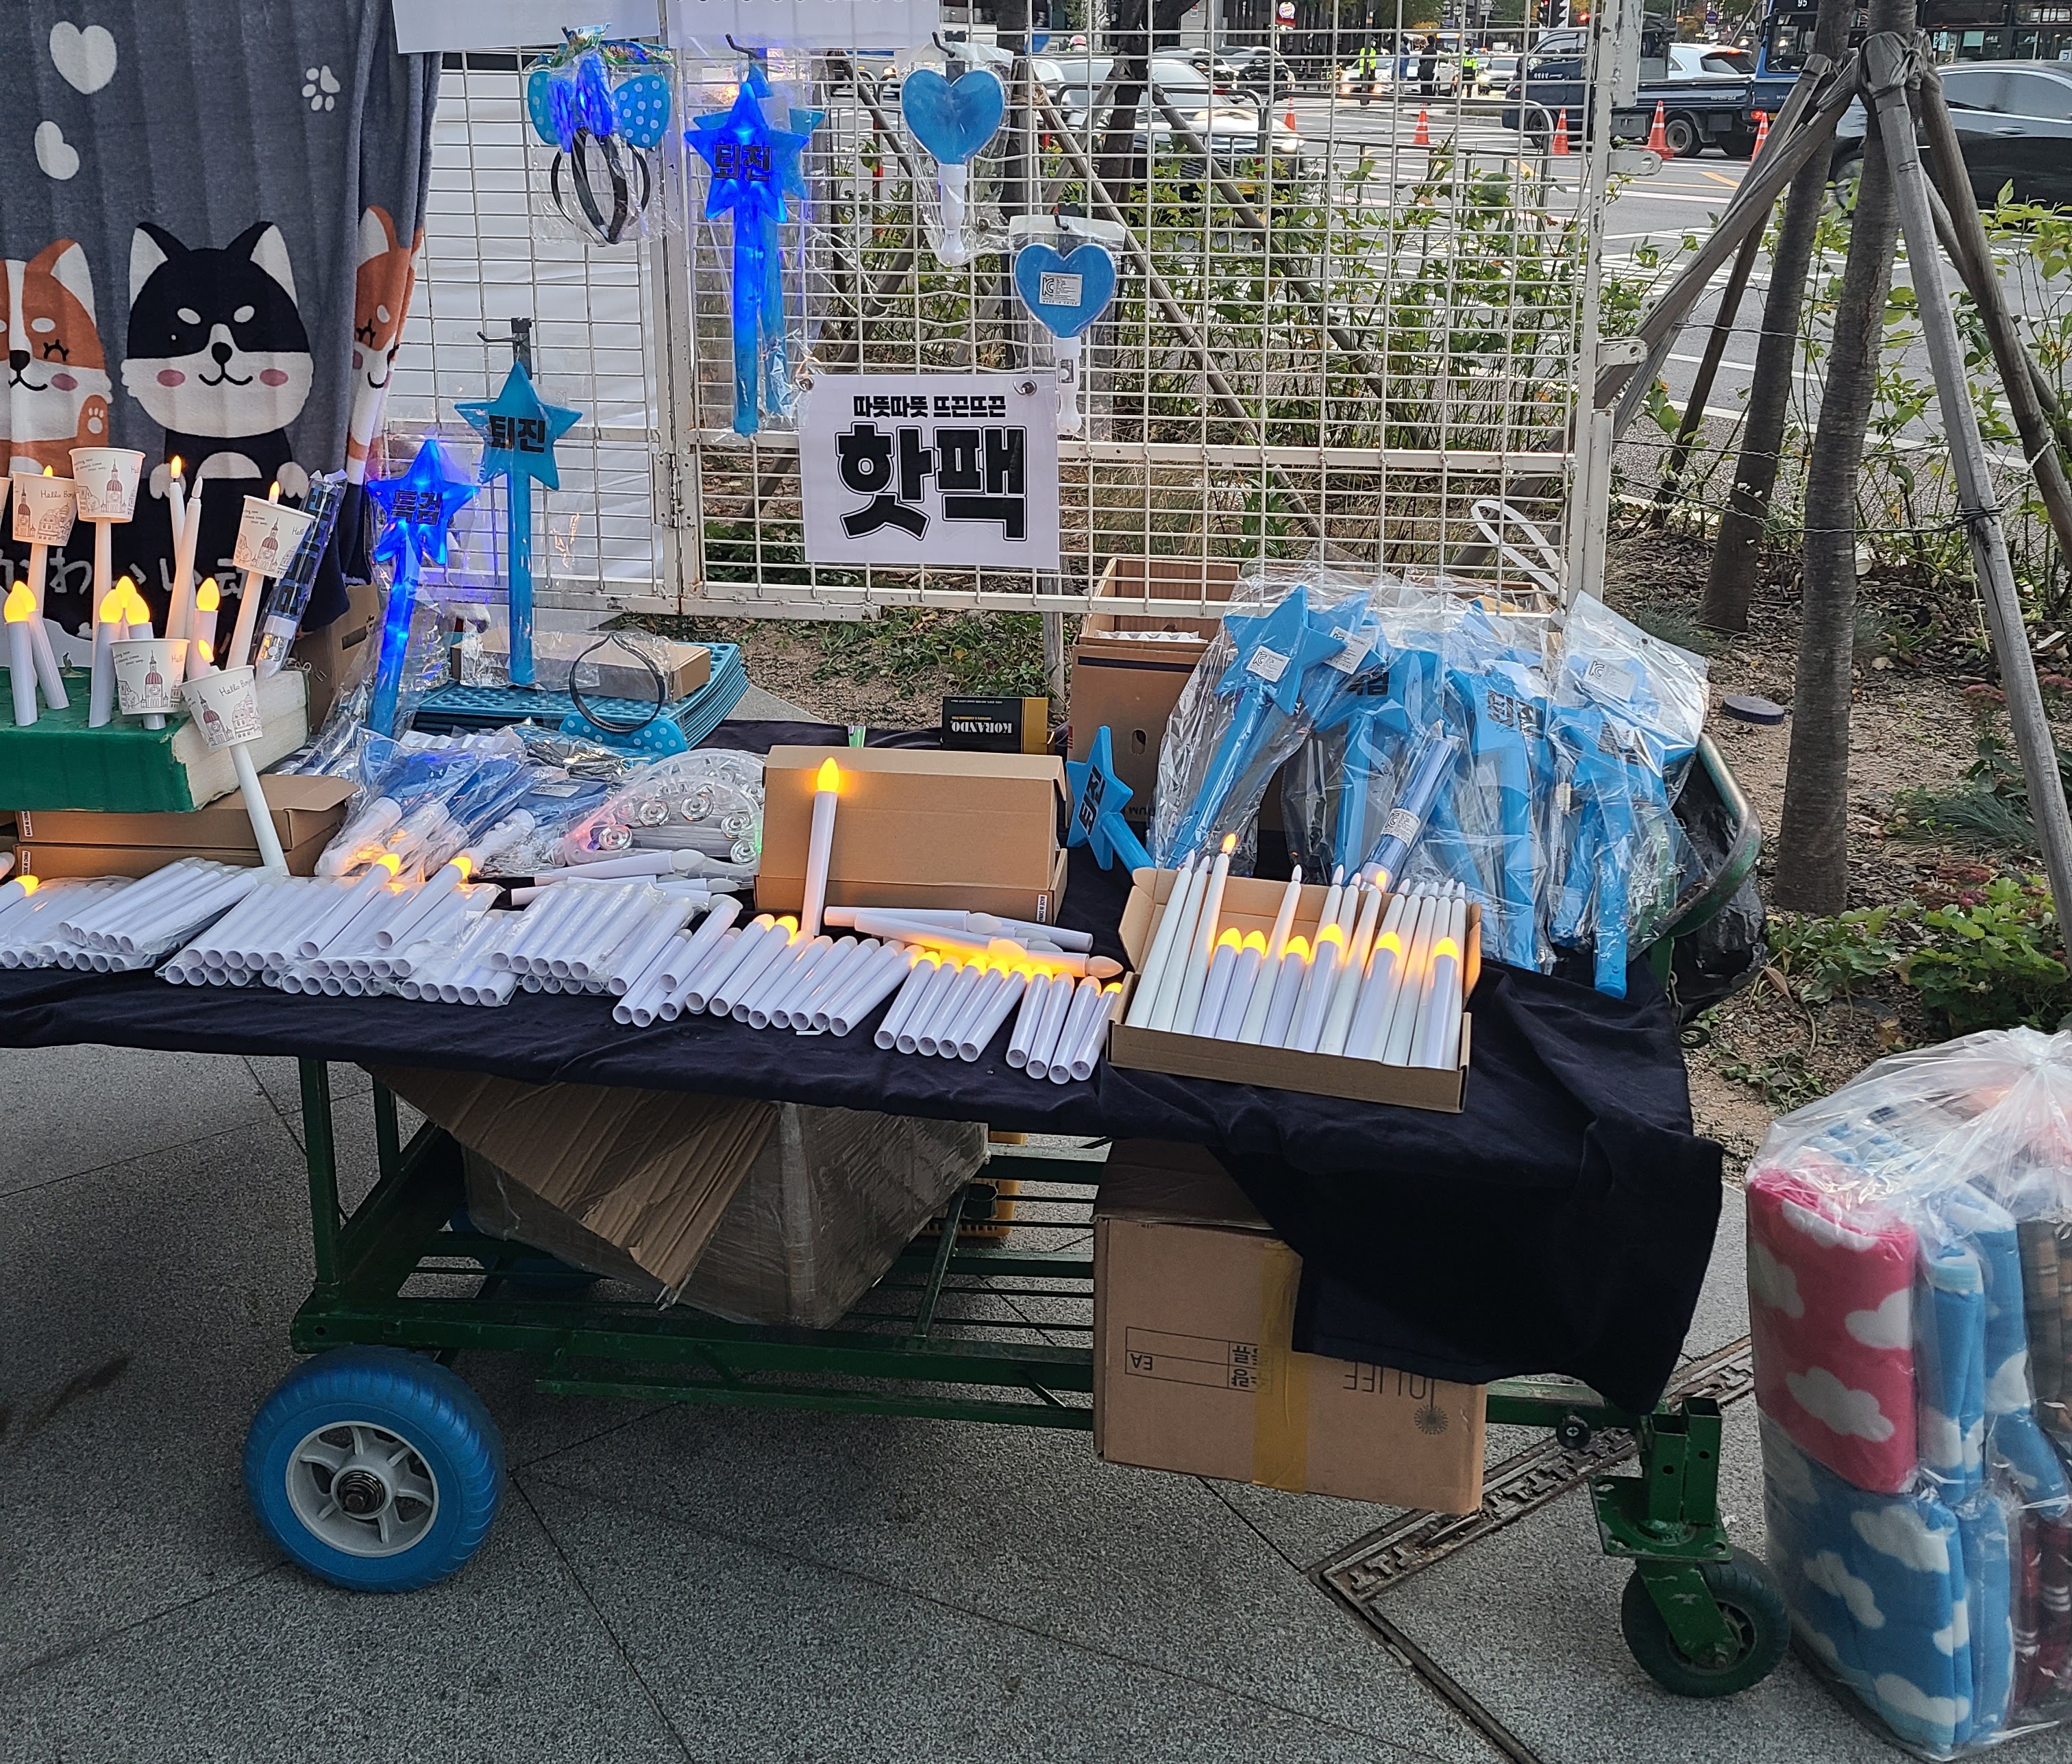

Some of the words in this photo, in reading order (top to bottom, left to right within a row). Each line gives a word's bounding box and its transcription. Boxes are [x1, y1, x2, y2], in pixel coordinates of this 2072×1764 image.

[714, 144, 772, 182] 퇴진
[853, 395, 929, 418] 따뜻따뜻
[933, 395, 1006, 418] 뜨끈뜨끈
[489, 414, 547, 454] 퇴진
[834, 421, 1028, 541] 핫팩
[391, 490, 443, 526] 특검
[219, 684, 240, 697] Hello
[951, 721, 1013, 734] KORANDO
[1078, 764, 1106, 837] 퇴진
[1130, 1353, 1153, 1371] EA
